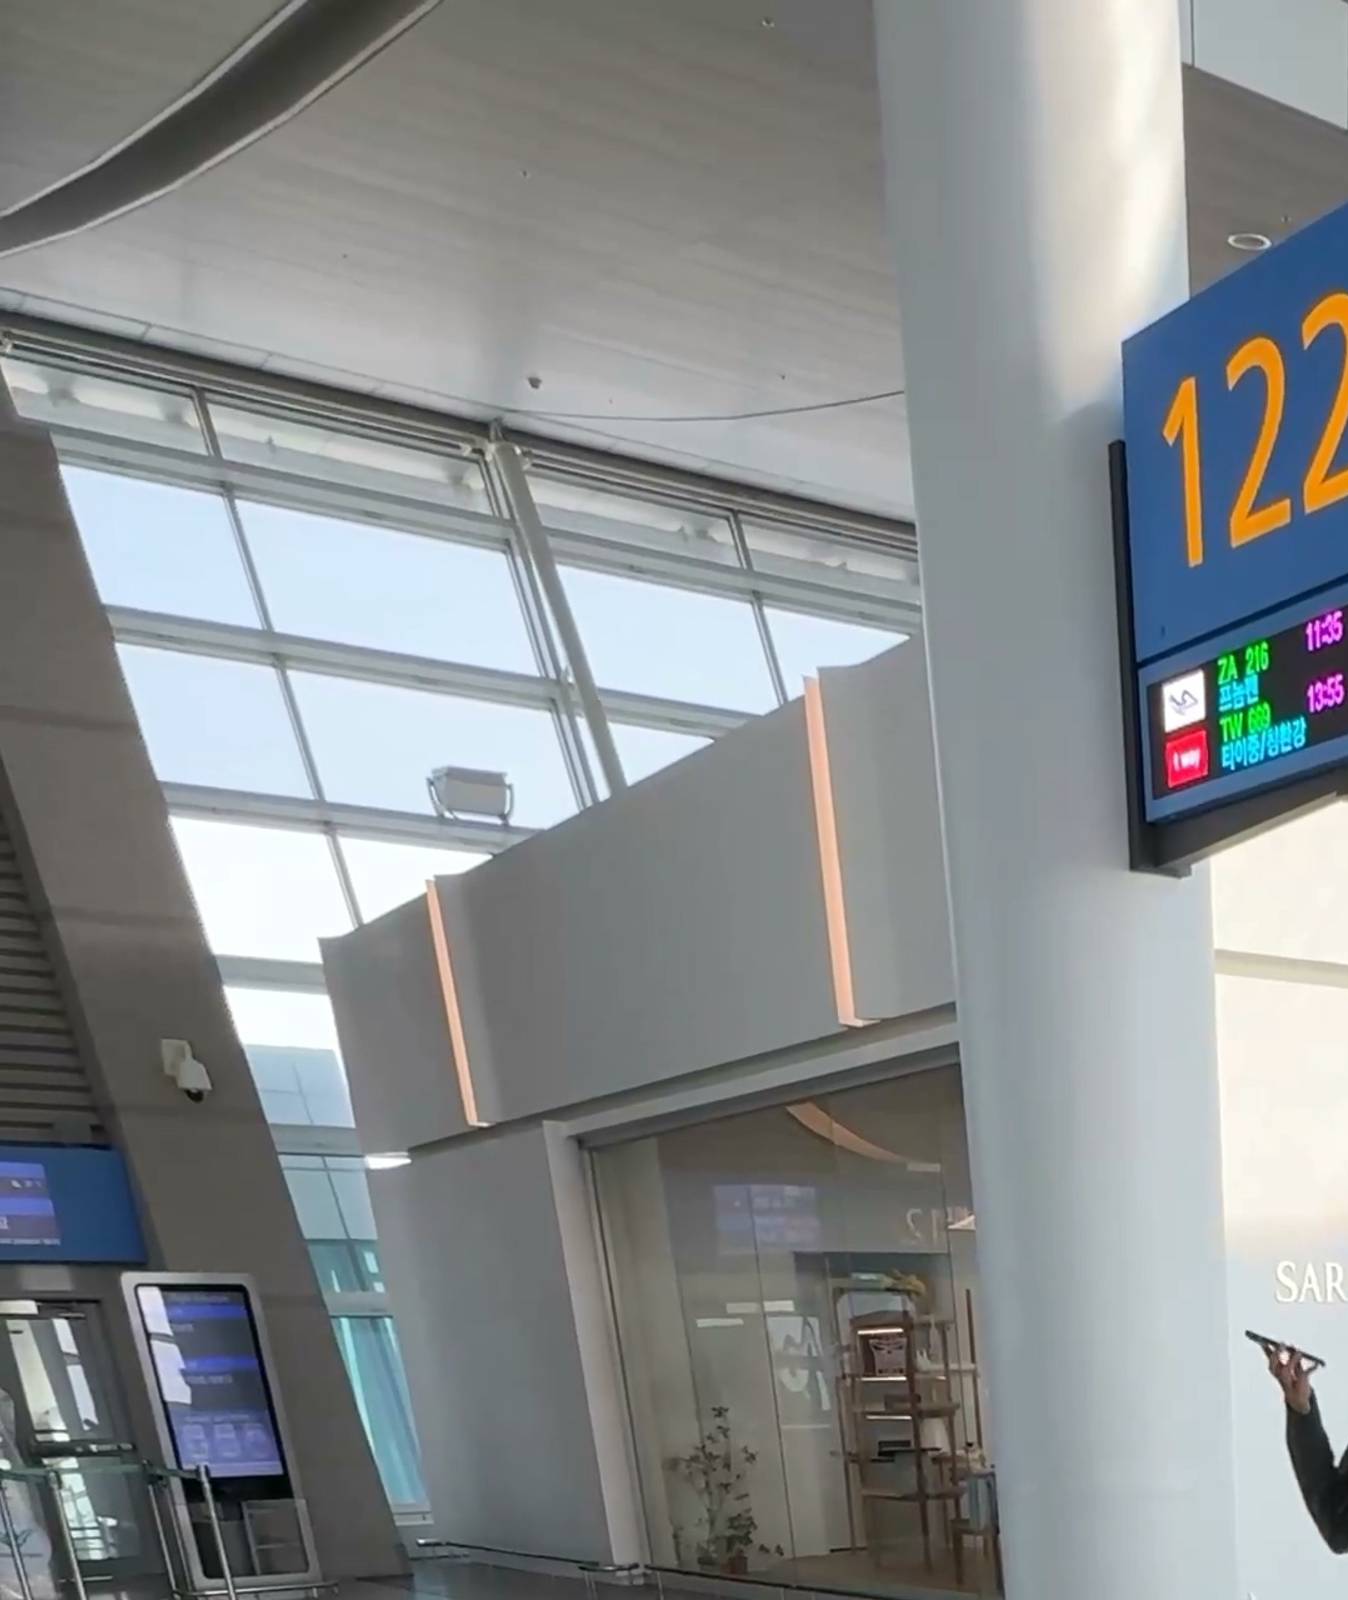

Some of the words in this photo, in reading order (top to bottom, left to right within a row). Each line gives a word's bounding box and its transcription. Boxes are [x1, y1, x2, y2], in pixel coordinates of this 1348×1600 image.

[1217, 655, 1238, 685] ZA
[1245, 642, 1270, 675] 216
[1219, 712, 1243, 742] TW
[1307, 674, 1345, 713] 13:55
